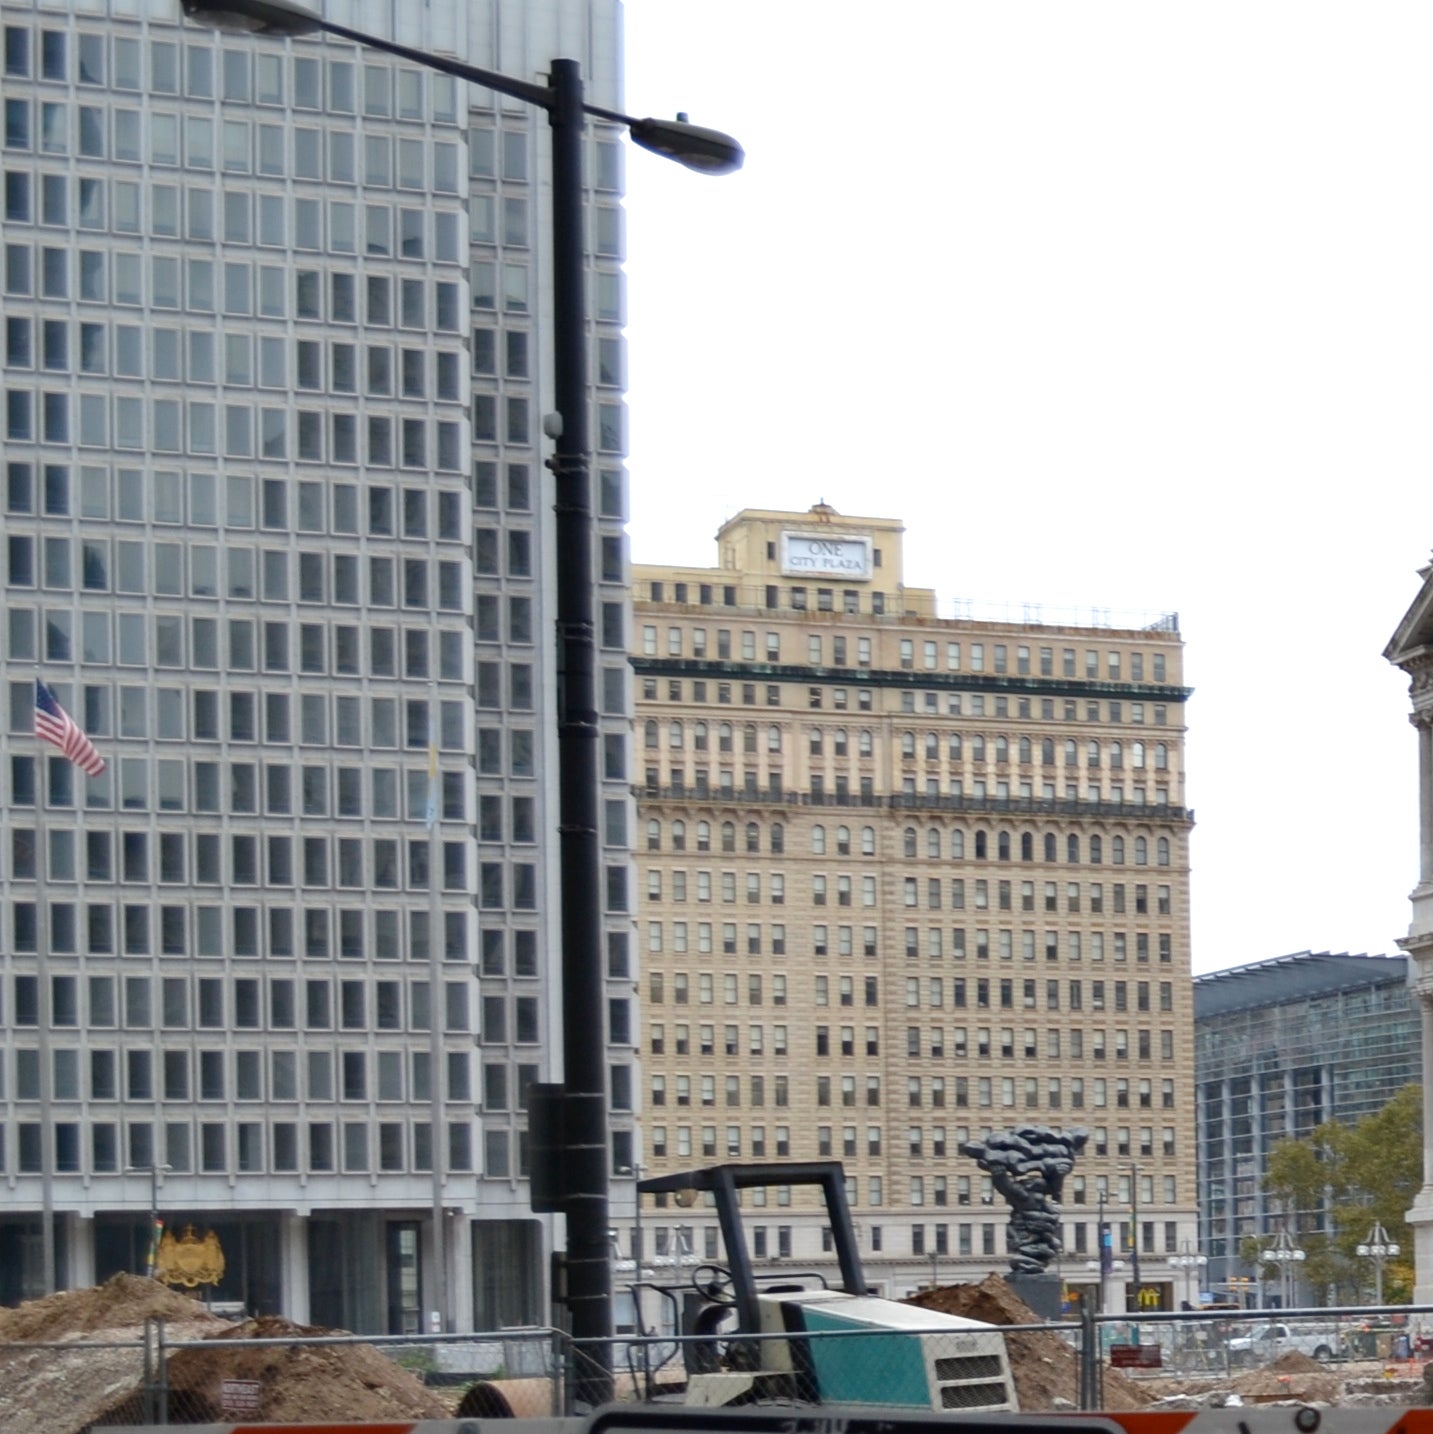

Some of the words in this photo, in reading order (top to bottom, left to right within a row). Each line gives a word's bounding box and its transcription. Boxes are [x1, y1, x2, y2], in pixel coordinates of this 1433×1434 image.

[809, 541, 843, 556] ONE
[790, 556, 817, 567] CITY
[822, 558, 863, 569] PLAZA
